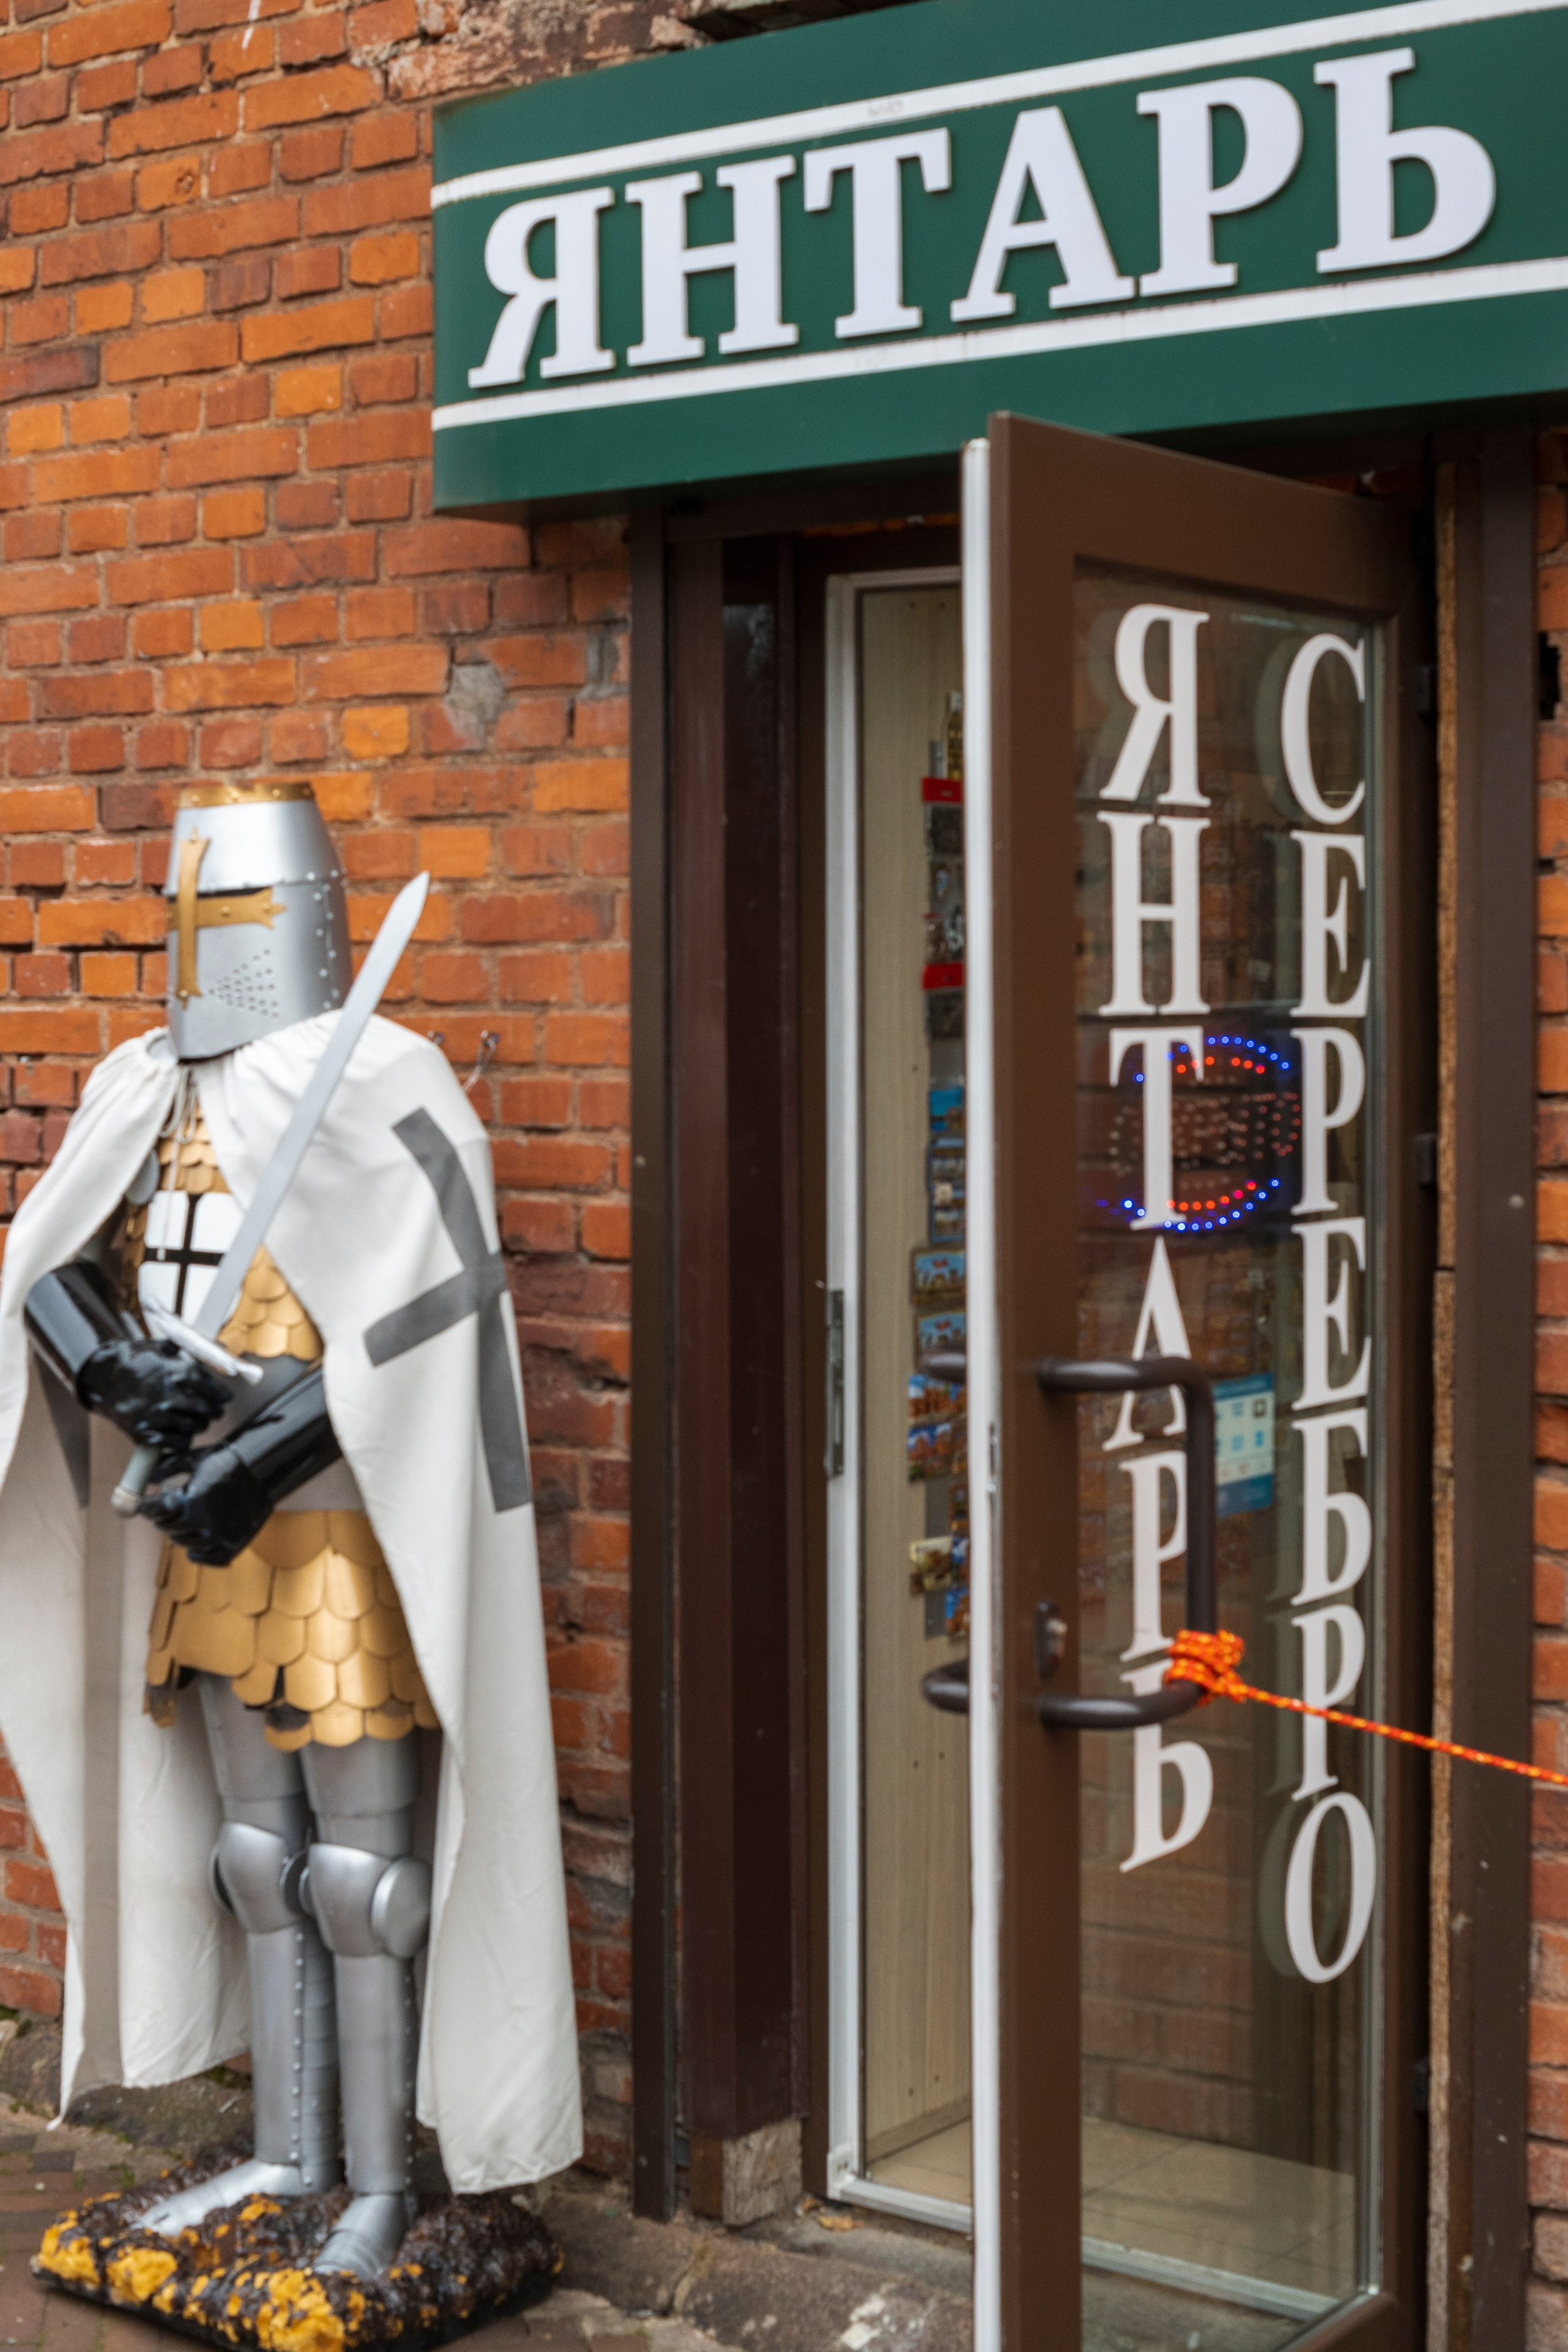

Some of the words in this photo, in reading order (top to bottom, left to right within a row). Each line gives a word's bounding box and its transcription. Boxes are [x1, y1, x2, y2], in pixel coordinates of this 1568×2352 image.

[468, 47, 1496, 388] ЯНТАРЬ
[1098, 603, 1213, 1872] ЯНТАРЬ
[1282, 633, 1376, 1983] СЕРЕБРО
